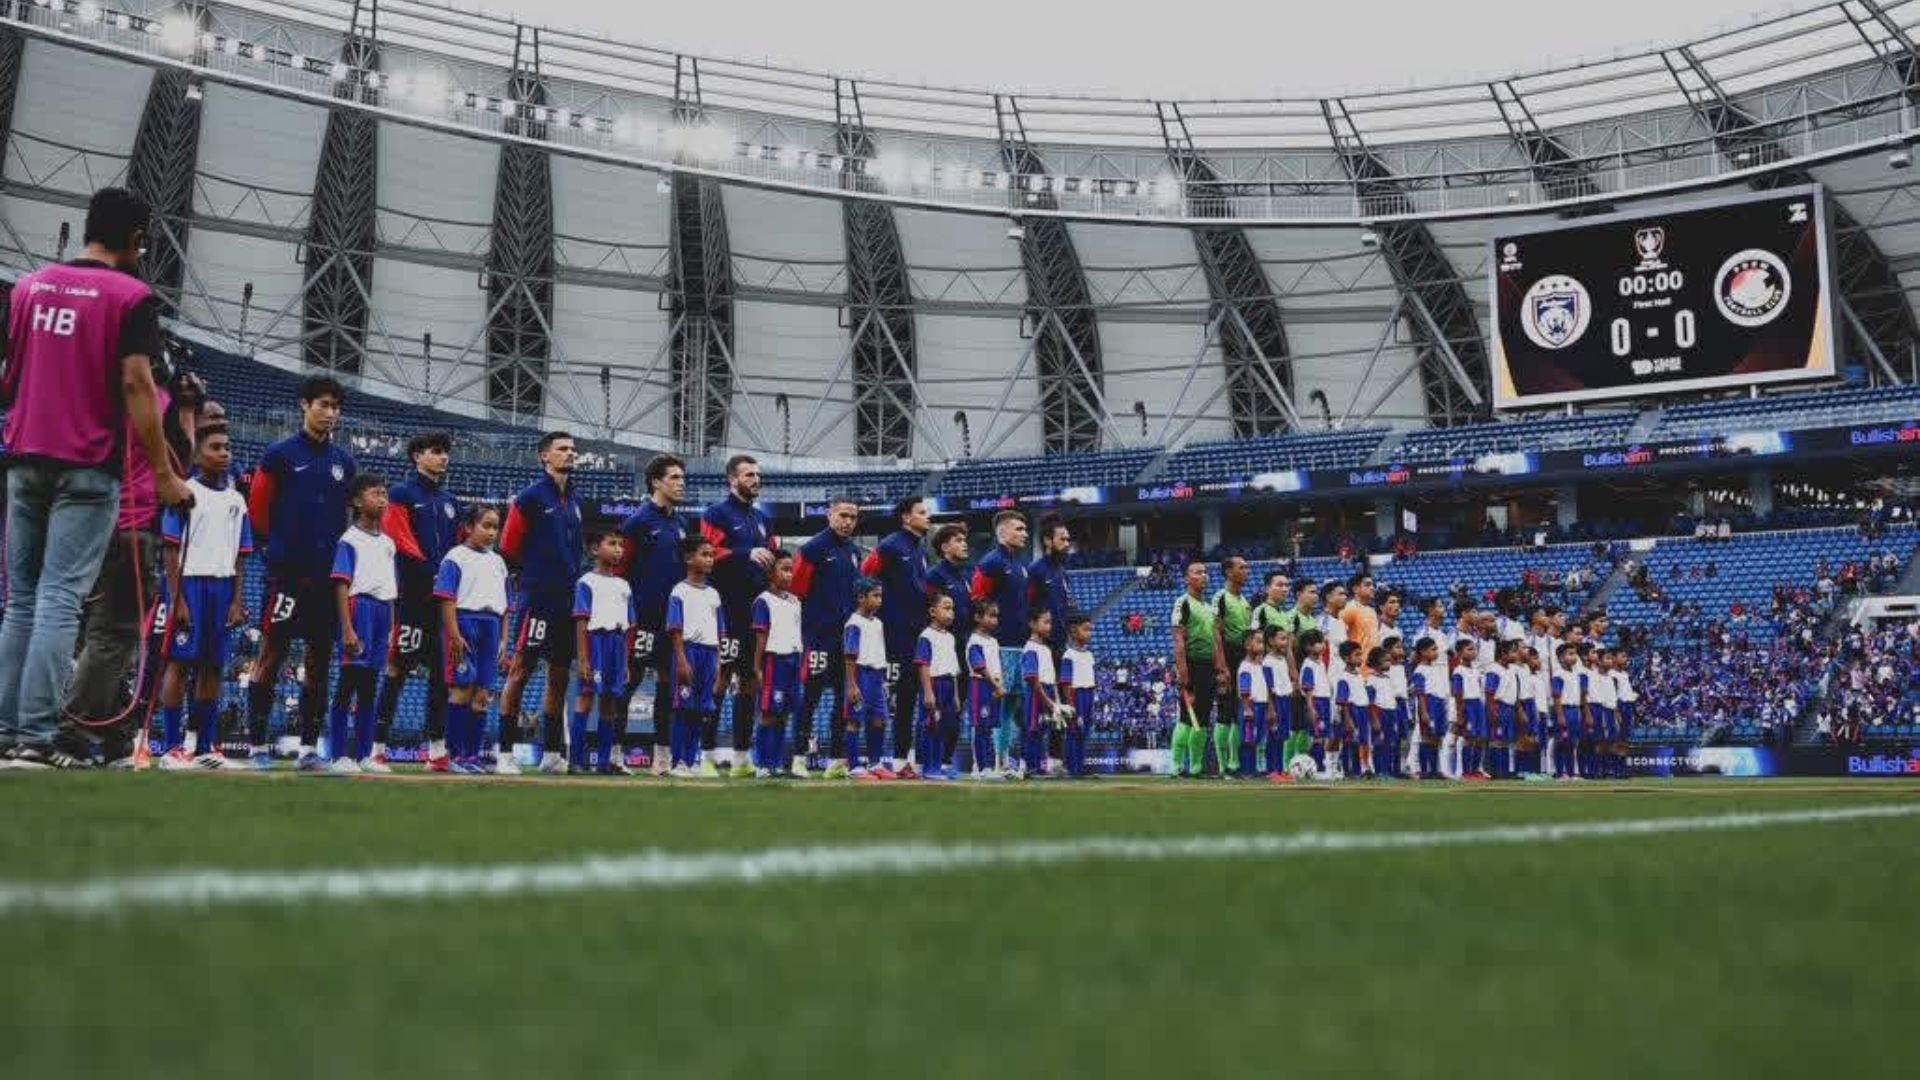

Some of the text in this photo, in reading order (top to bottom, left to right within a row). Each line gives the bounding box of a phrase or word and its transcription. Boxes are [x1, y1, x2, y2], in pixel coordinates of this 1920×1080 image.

[1619, 270, 1684, 297] 00:00
[32, 304, 77, 336] HB
[1611, 317, 1631, 356] 0
[1675, 309, 1696, 348] 0
[273, 592, 296, 619] 13
[398, 624, 422, 649] 20
[528, 617, 547, 640] 18
[720, 637, 740, 658] 36
[809, 650, 829, 669] 95
[1848, 755, 1920, 773] Bullisha
